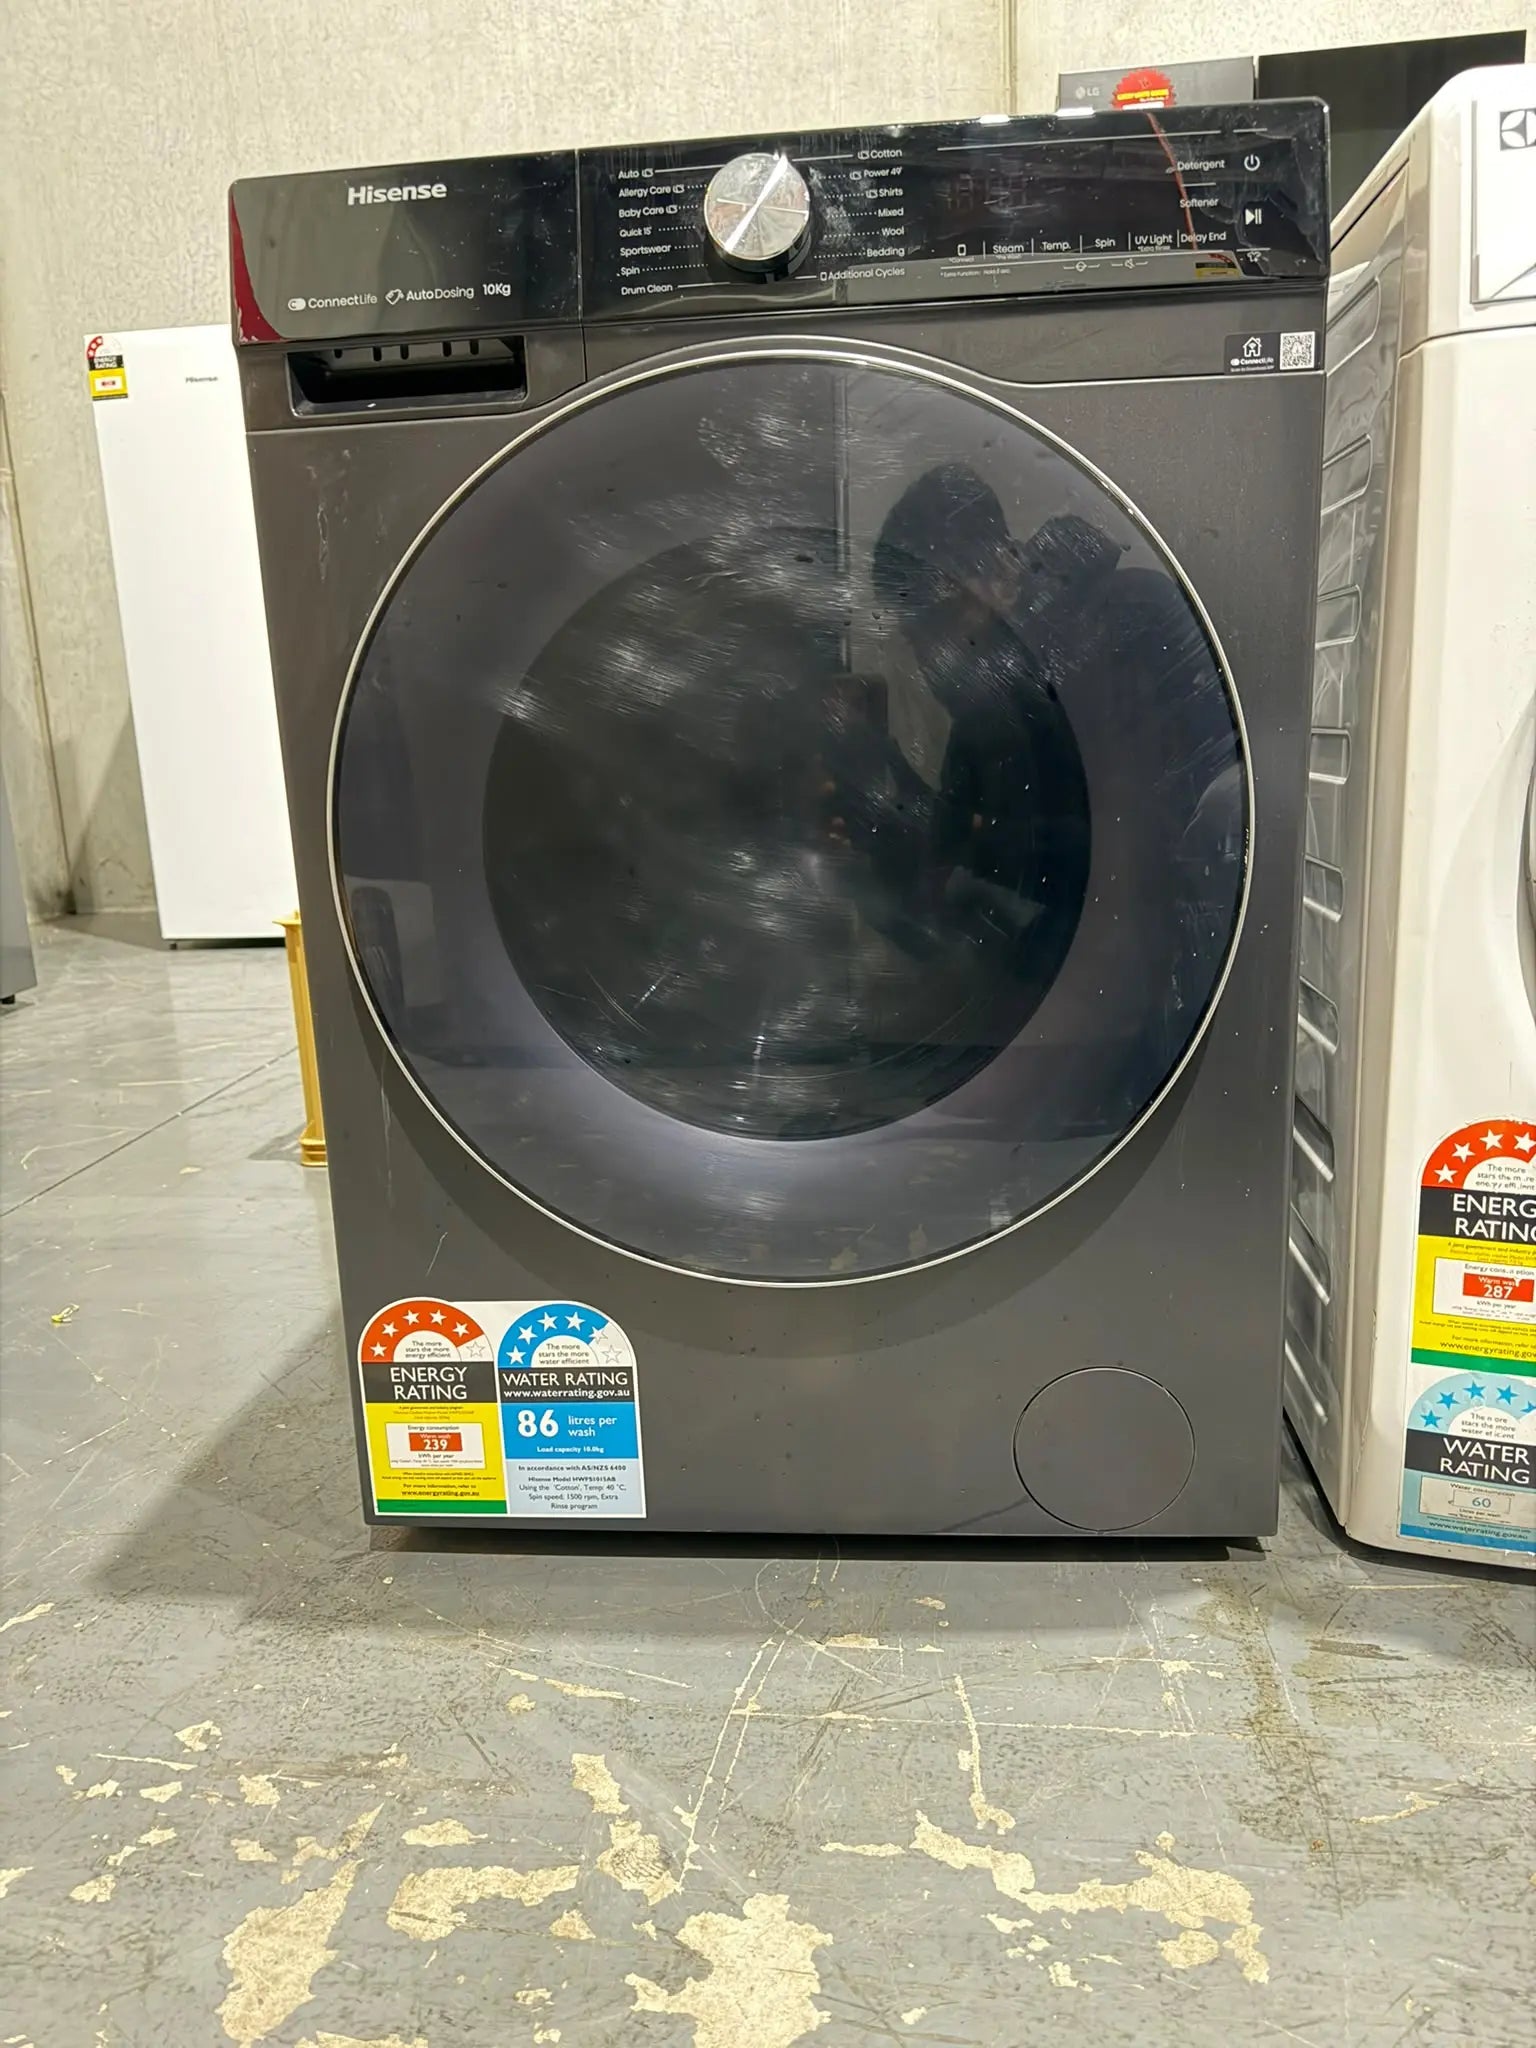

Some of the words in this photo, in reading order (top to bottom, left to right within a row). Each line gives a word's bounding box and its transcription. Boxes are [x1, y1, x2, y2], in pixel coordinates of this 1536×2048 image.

[1086, 87, 1100, 96] LG
[870, 148, 902, 159] Cotton
[1177, 159, 1225, 171] Detergent
[618, 170, 639, 180] Auto
[864, 168, 890, 178] Power
[347, 183, 448, 206] Hisense
[618, 188, 648, 198] Allergy
[650, 186, 671, 194] Care
[879, 188, 904, 198] Shirts
[1179, 198, 1219, 208] Softener
[618, 208, 642, 218] Baby
[642, 206, 664, 215] Care
[878, 208, 904, 218] Mixed
[619, 228, 642, 238] Quick
[882, 226, 905, 236] Wool
[1134, 234, 1148, 245] UV
[1150, 234, 1172, 245] Light
[1180, 233, 1207, 244] Delay
[1208, 231, 1226, 241] End
[992, 244, 1024, 254] Steam
[1042, 241, 1071, 251] Temp.
[1095, 238, 1116, 249] Spin
[620, 245, 671, 257] Sportswear
[866, 247, 905, 258] Bedding
[620, 266, 640, 276] Spin
[828, 269, 874, 280] Additional
[875, 268, 905, 278] Cycles
[406, 286, 475, 303] AutoDosing
[482, 282, 512, 296] 10Kg
[621, 286, 645, 295] Drum
[647, 284, 673, 294] Clean
[308, 294, 378, 308] ConnectLife
[1488, 1164, 1503, 1172] The
[1465, 1263, 1488, 1272] Energy
[1484, 1284, 1513, 1299] 287
[390, 1367, 468, 1383] ENERGY
[502, 1373, 560, 1386] WATER
[565, 1372, 628, 1385] RATING
[394, 1384, 467, 1400] RATING
[504, 1388, 630, 1399] www.waterrating.gov.au
[518, 1409, 559, 1437] 86
[568, 1416, 595, 1425] litres
[599, 1417, 617, 1427] per
[568, 1427, 596, 1437] wash
[423, 1439, 448, 1450] 239
[1443, 1437, 1530, 1465] WATER
[1440, 1457, 1530, 1483] RATING
[1472, 1497, 1491, 1508] 60
